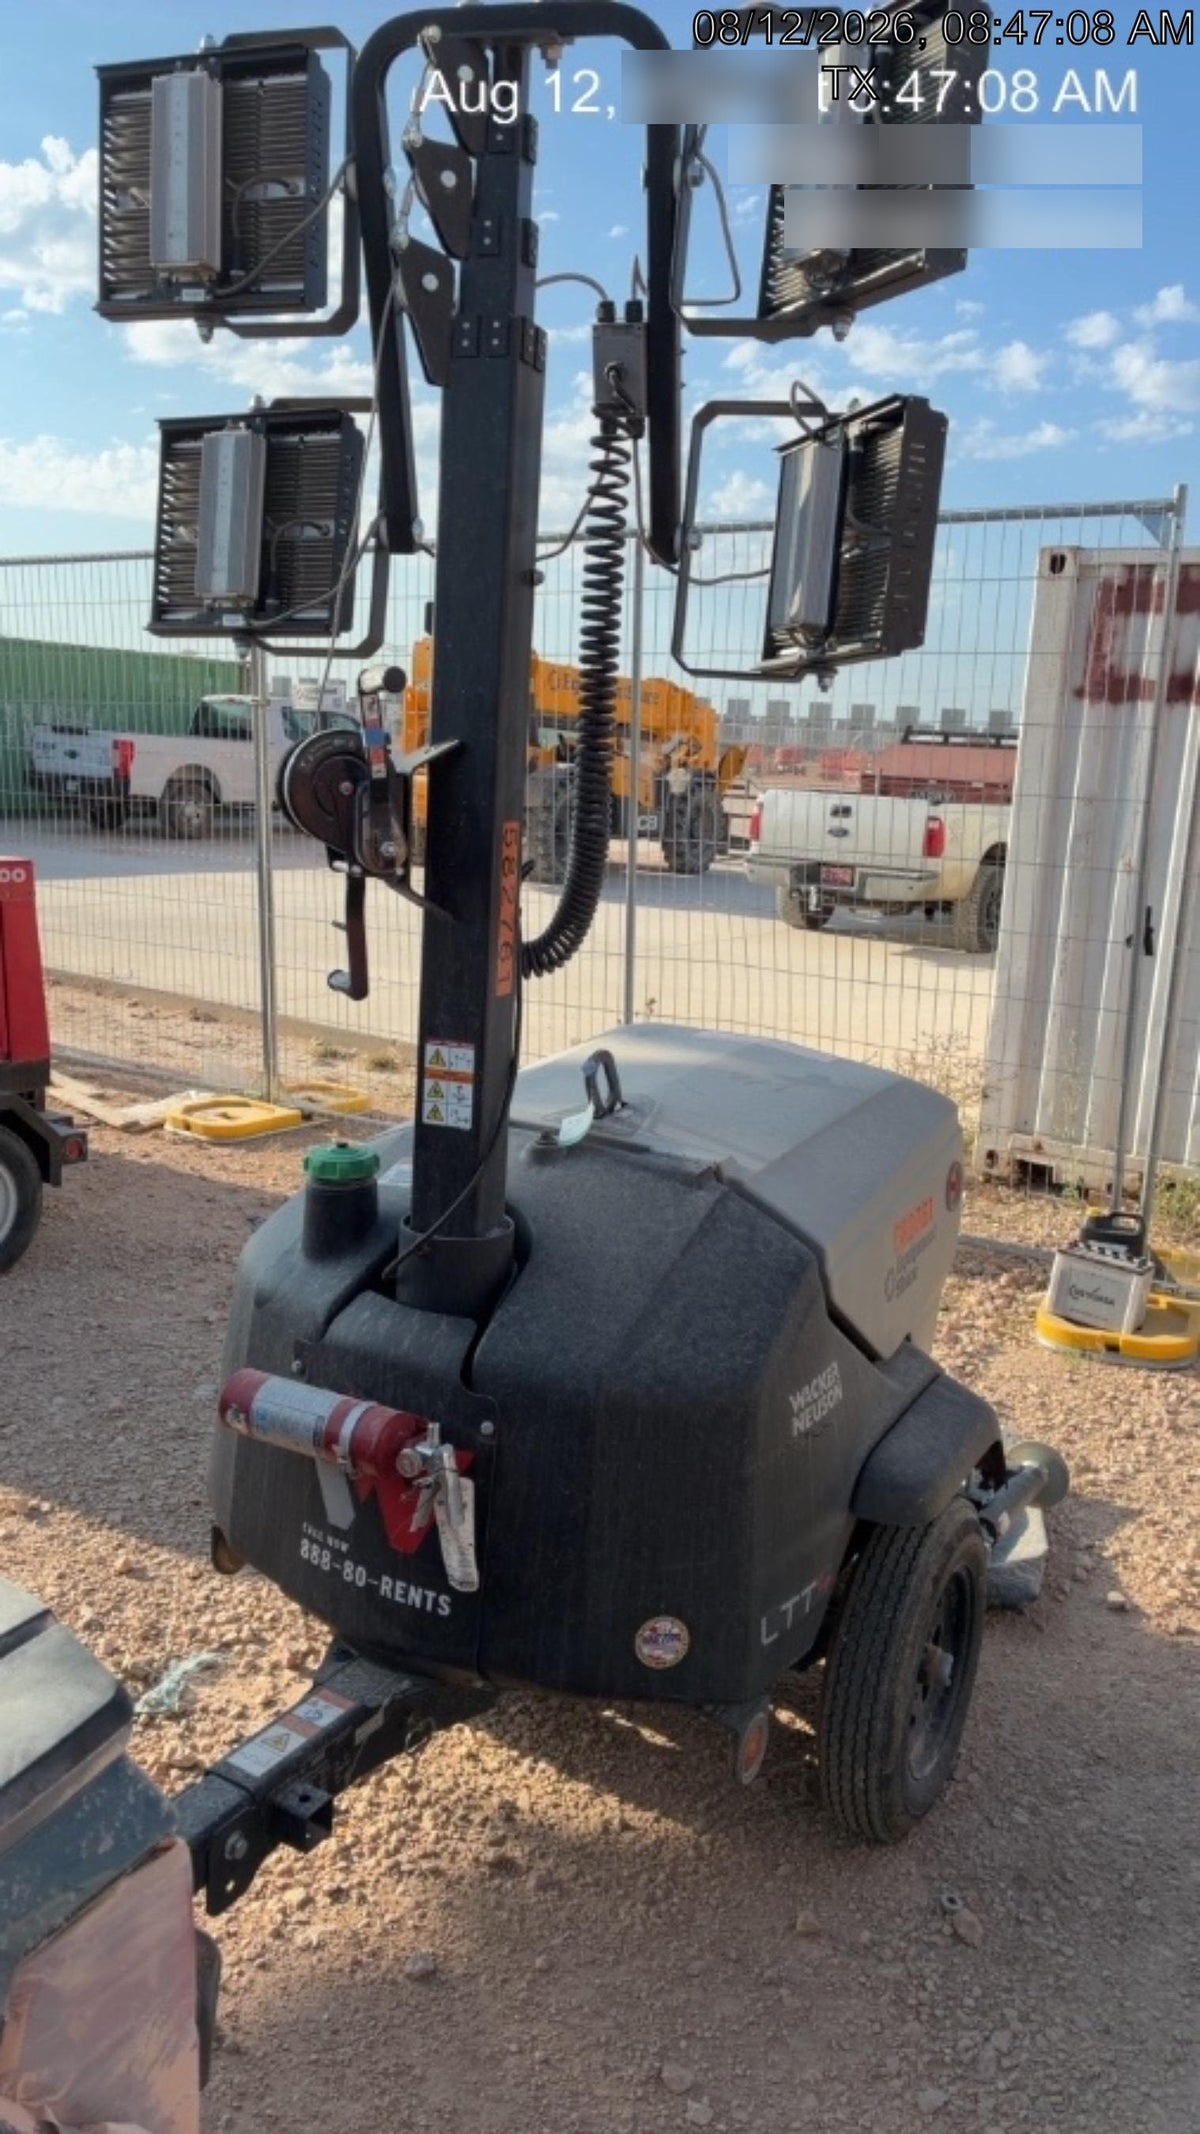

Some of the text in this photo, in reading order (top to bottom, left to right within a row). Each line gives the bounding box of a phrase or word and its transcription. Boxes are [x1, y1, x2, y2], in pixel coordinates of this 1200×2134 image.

[790, 1362, 840, 1412] WACKER
[792, 1383, 843, 1437] NEUSON
[327, 1535, 349, 1552] NOW
[299, 1539, 451, 1615] 888-80-RENTS
